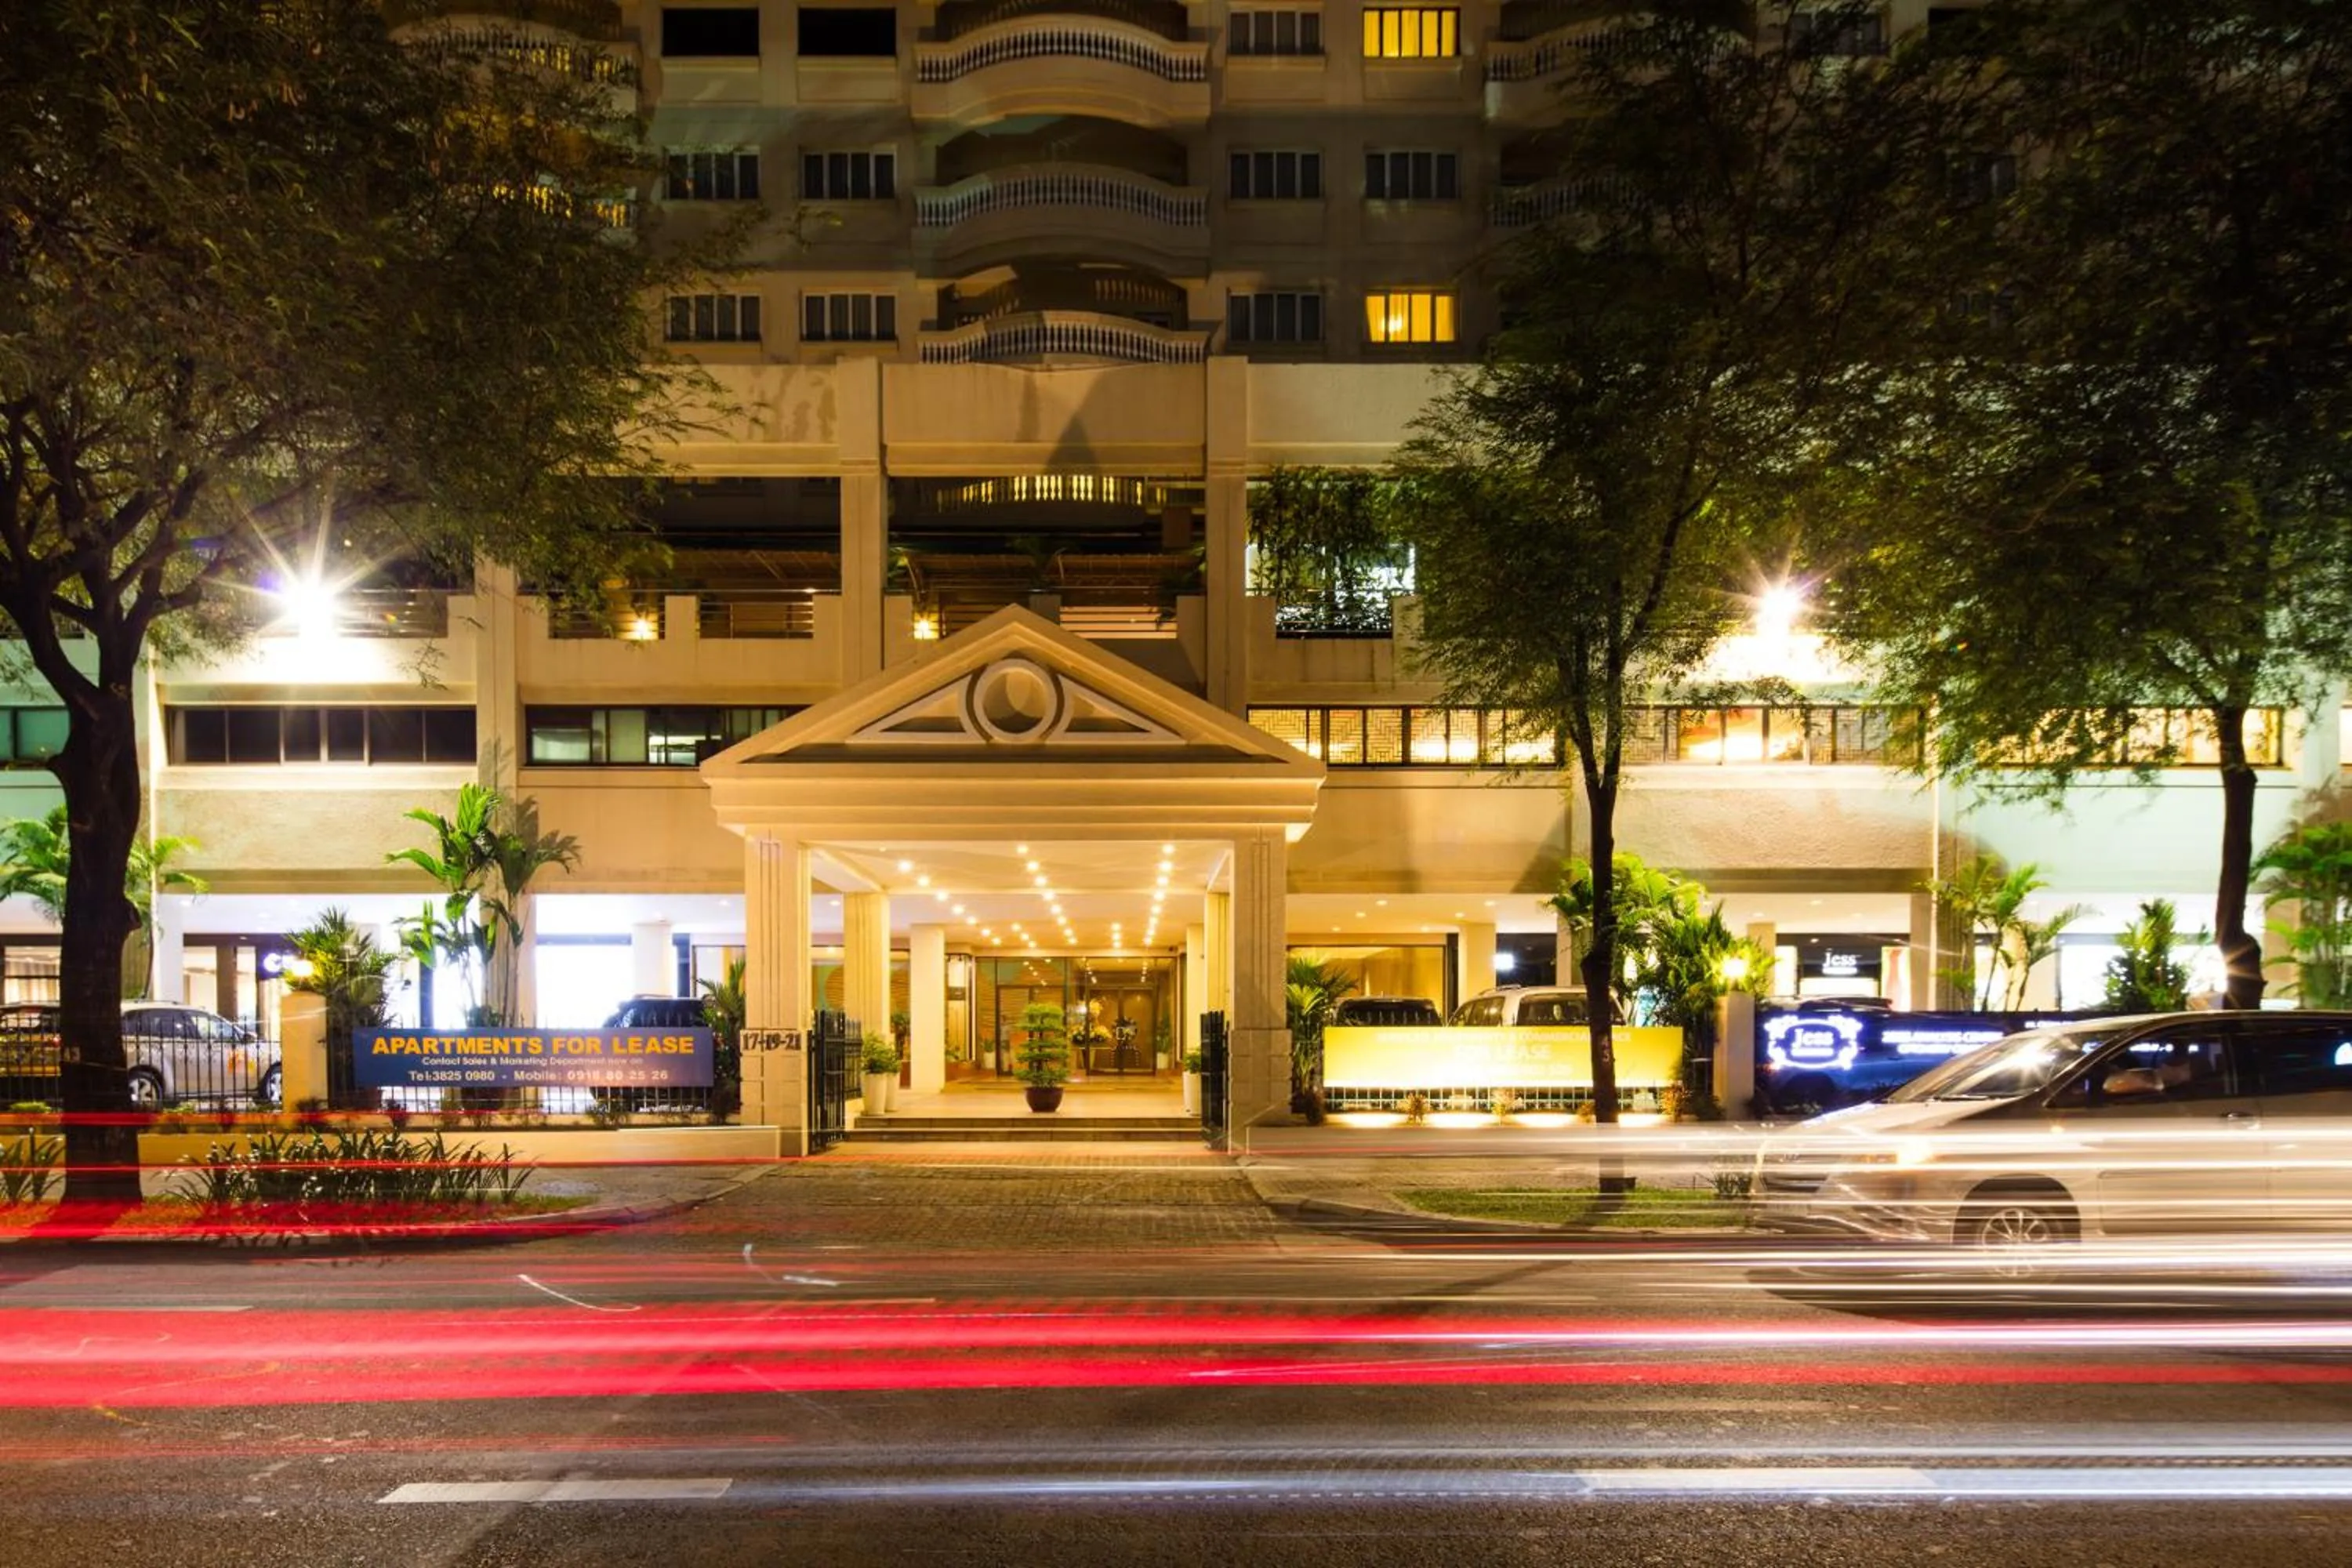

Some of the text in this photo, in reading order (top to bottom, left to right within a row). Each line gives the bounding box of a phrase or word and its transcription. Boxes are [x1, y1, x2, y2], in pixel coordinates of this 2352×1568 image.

[372, 1036, 695, 1054] APARTMENTS FOR LEASE
[742, 1033, 801, 1051] 17-19-21
[422, 1056, 460, 1065] Contact
[463, 1056, 487, 1065] Sales
[499, 1056, 547, 1067] Marketing
